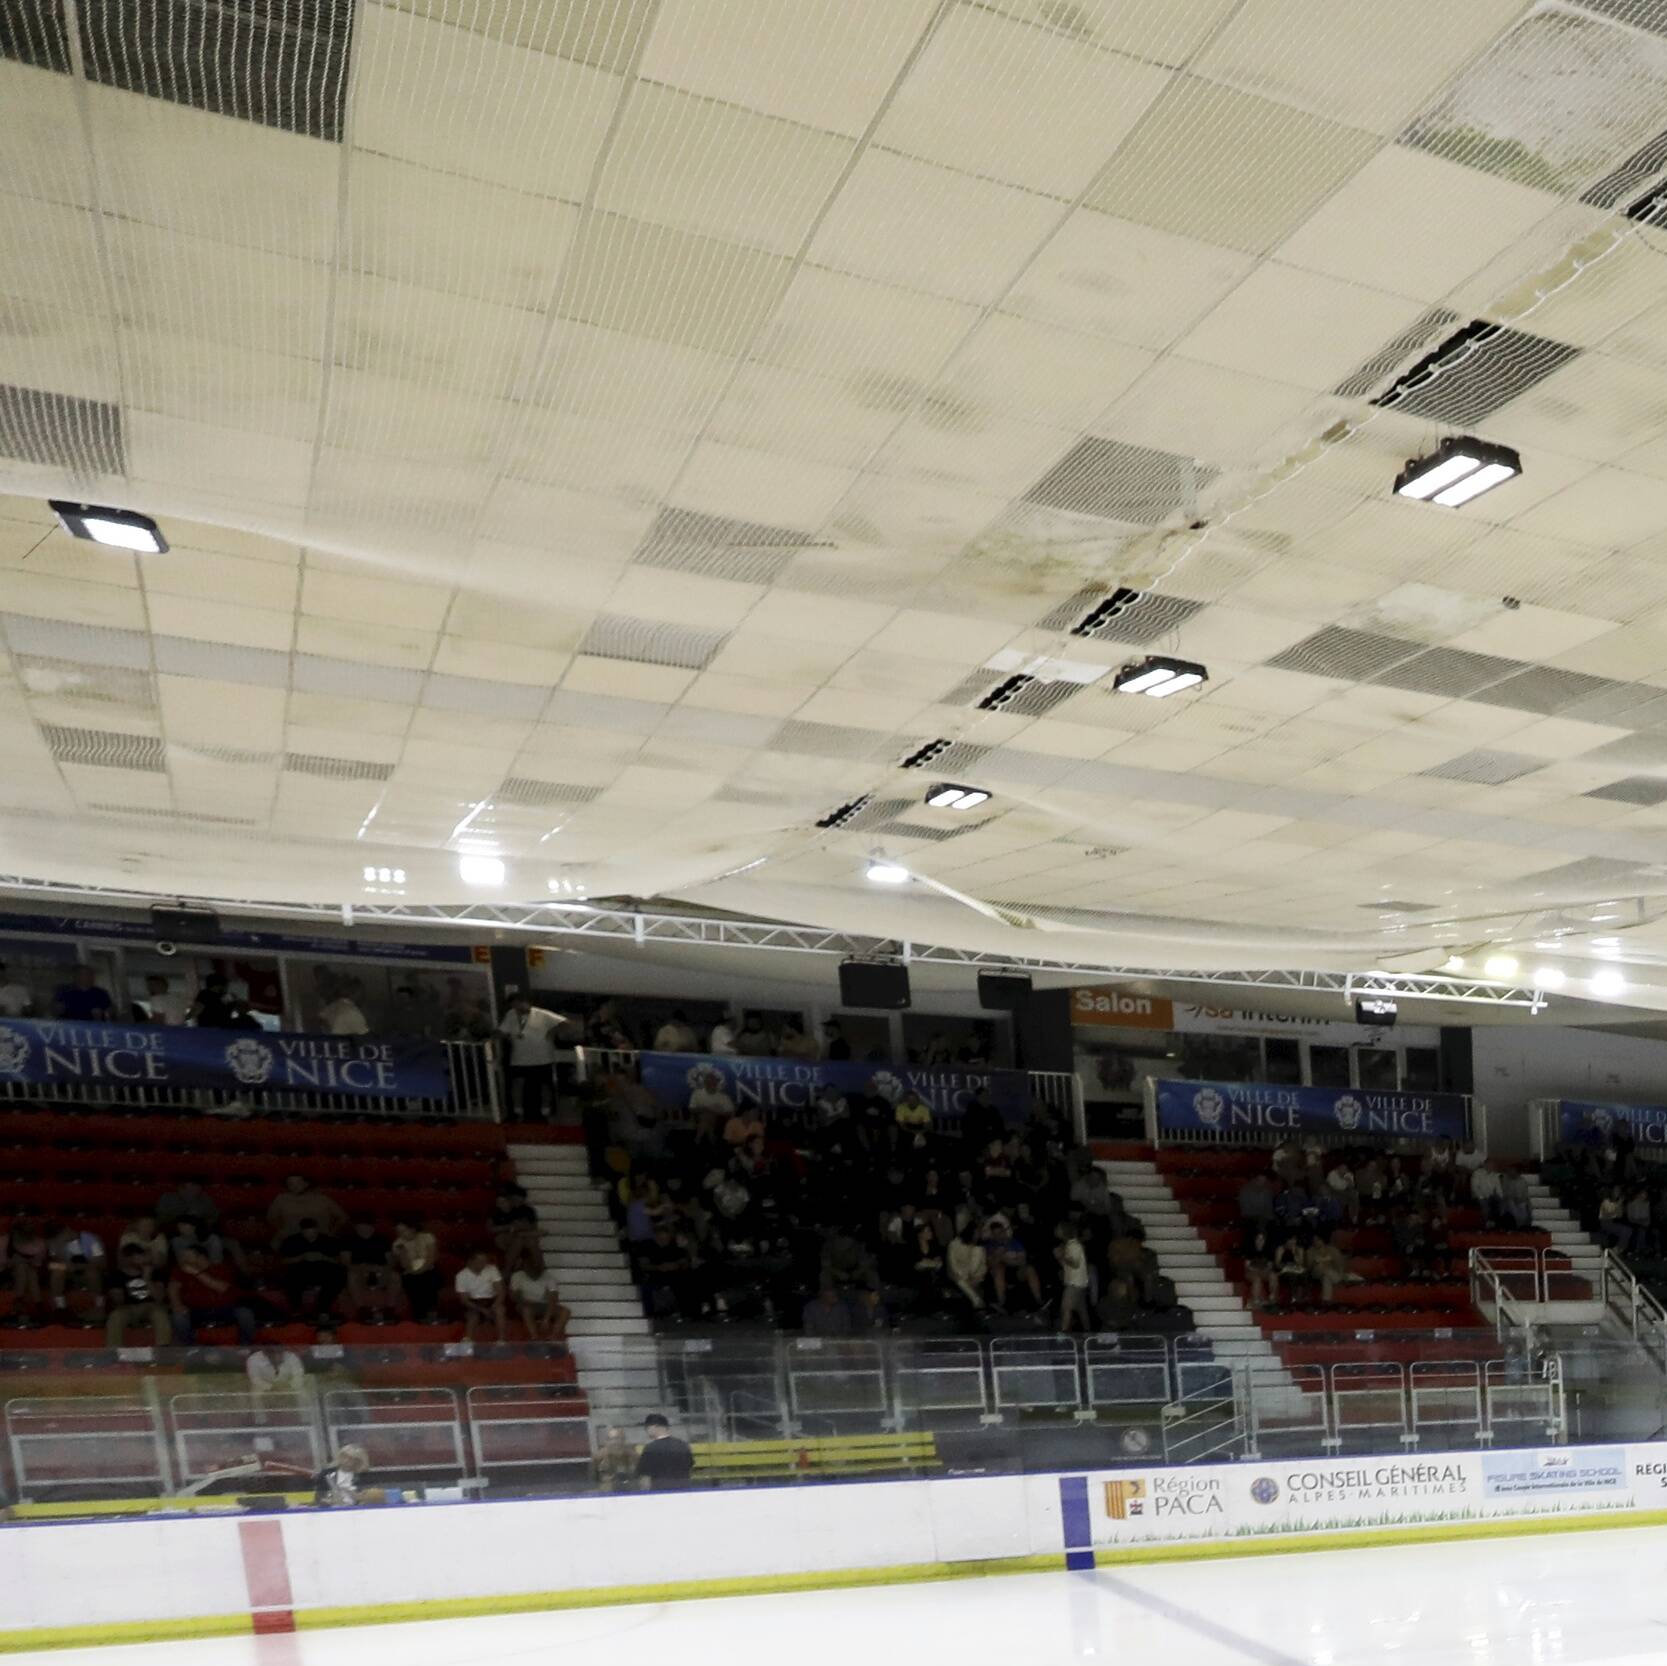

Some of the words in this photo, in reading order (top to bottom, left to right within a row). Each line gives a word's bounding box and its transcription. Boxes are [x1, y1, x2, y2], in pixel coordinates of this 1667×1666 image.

[1074, 990, 1152, 1015] Salon
[35, 1023, 115, 1047] VILLE
[124, 1030, 166, 1050] DE
[278, 1039, 350, 1060] VILLE
[359, 1044, 394, 1062] DE
[44, 1046, 169, 1079] NICE
[284, 1058, 398, 1089] NICE
[732, 1062, 791, 1081] VILLE
[794, 1066, 826, 1083] DE
[907, 1071, 962, 1089] VILLE
[1228, 1088, 1275, 1103] VILLE
[1277, 1090, 1299, 1107] DE
[1366, 1095, 1407, 1110] VILLE
[1412, 1097, 1433, 1112] DE
[1231, 1103, 1302, 1129] NICE
[1368, 1110, 1433, 1133] NICE
[1287, 1470, 1373, 1492] CONSEIL
[1375, 1462, 1467, 1487] GÉNÉRAL
[1529, 1469, 1577, 1481] SKATING
[1579, 1466, 1623, 1477] SCHOOL
[1153, 1475, 1220, 1498] Région
[1154, 1494, 1223, 1517] PACA
